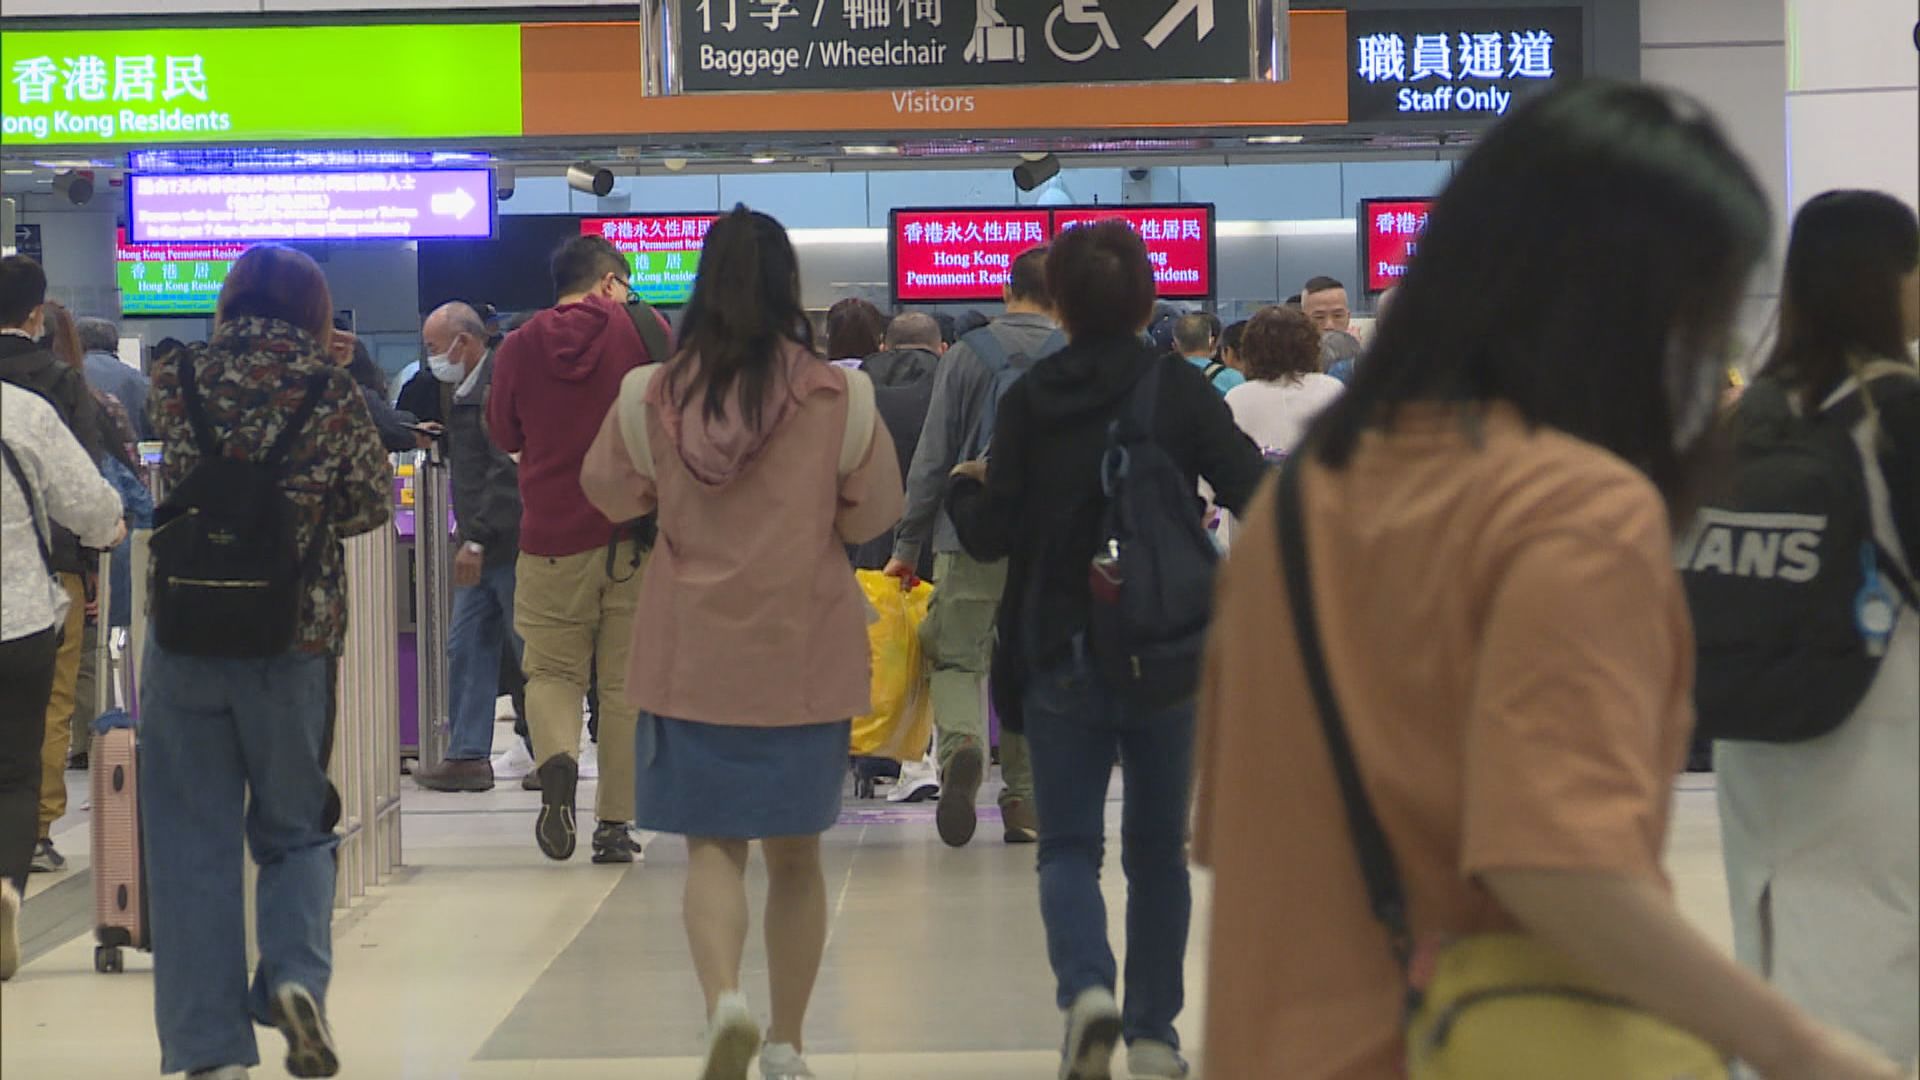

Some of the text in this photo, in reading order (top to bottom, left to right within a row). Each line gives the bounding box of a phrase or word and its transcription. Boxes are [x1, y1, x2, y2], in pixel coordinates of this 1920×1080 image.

[700, 44, 800, 75] Baggage
[819, 39, 947, 66] Wheelchair
[1359, 30, 1554, 81] 職員通道
[12, 54, 208, 103] 香港居民
[892, 90, 976, 113] Visitors
[1398, 86, 1511, 115] Staff Only
[1, 107, 230, 138] ong Kong Residents
[602, 219, 711, 239] 香港永久性居民
[904, 220, 1043, 244] 香港永久性居民
[168, 248, 210, 260] Permanent
[615, 240, 639, 252] Kong
[640, 238, 683, 250] Permanent
[934, 250, 1010, 268] Hong Kong
[637, 271, 660, 285] Kong
[906, 270, 975, 286] Permanent
[1153, 267, 1200, 282] sidents
[138, 281, 162, 294] Hong
[165, 281, 189, 294] Kong
